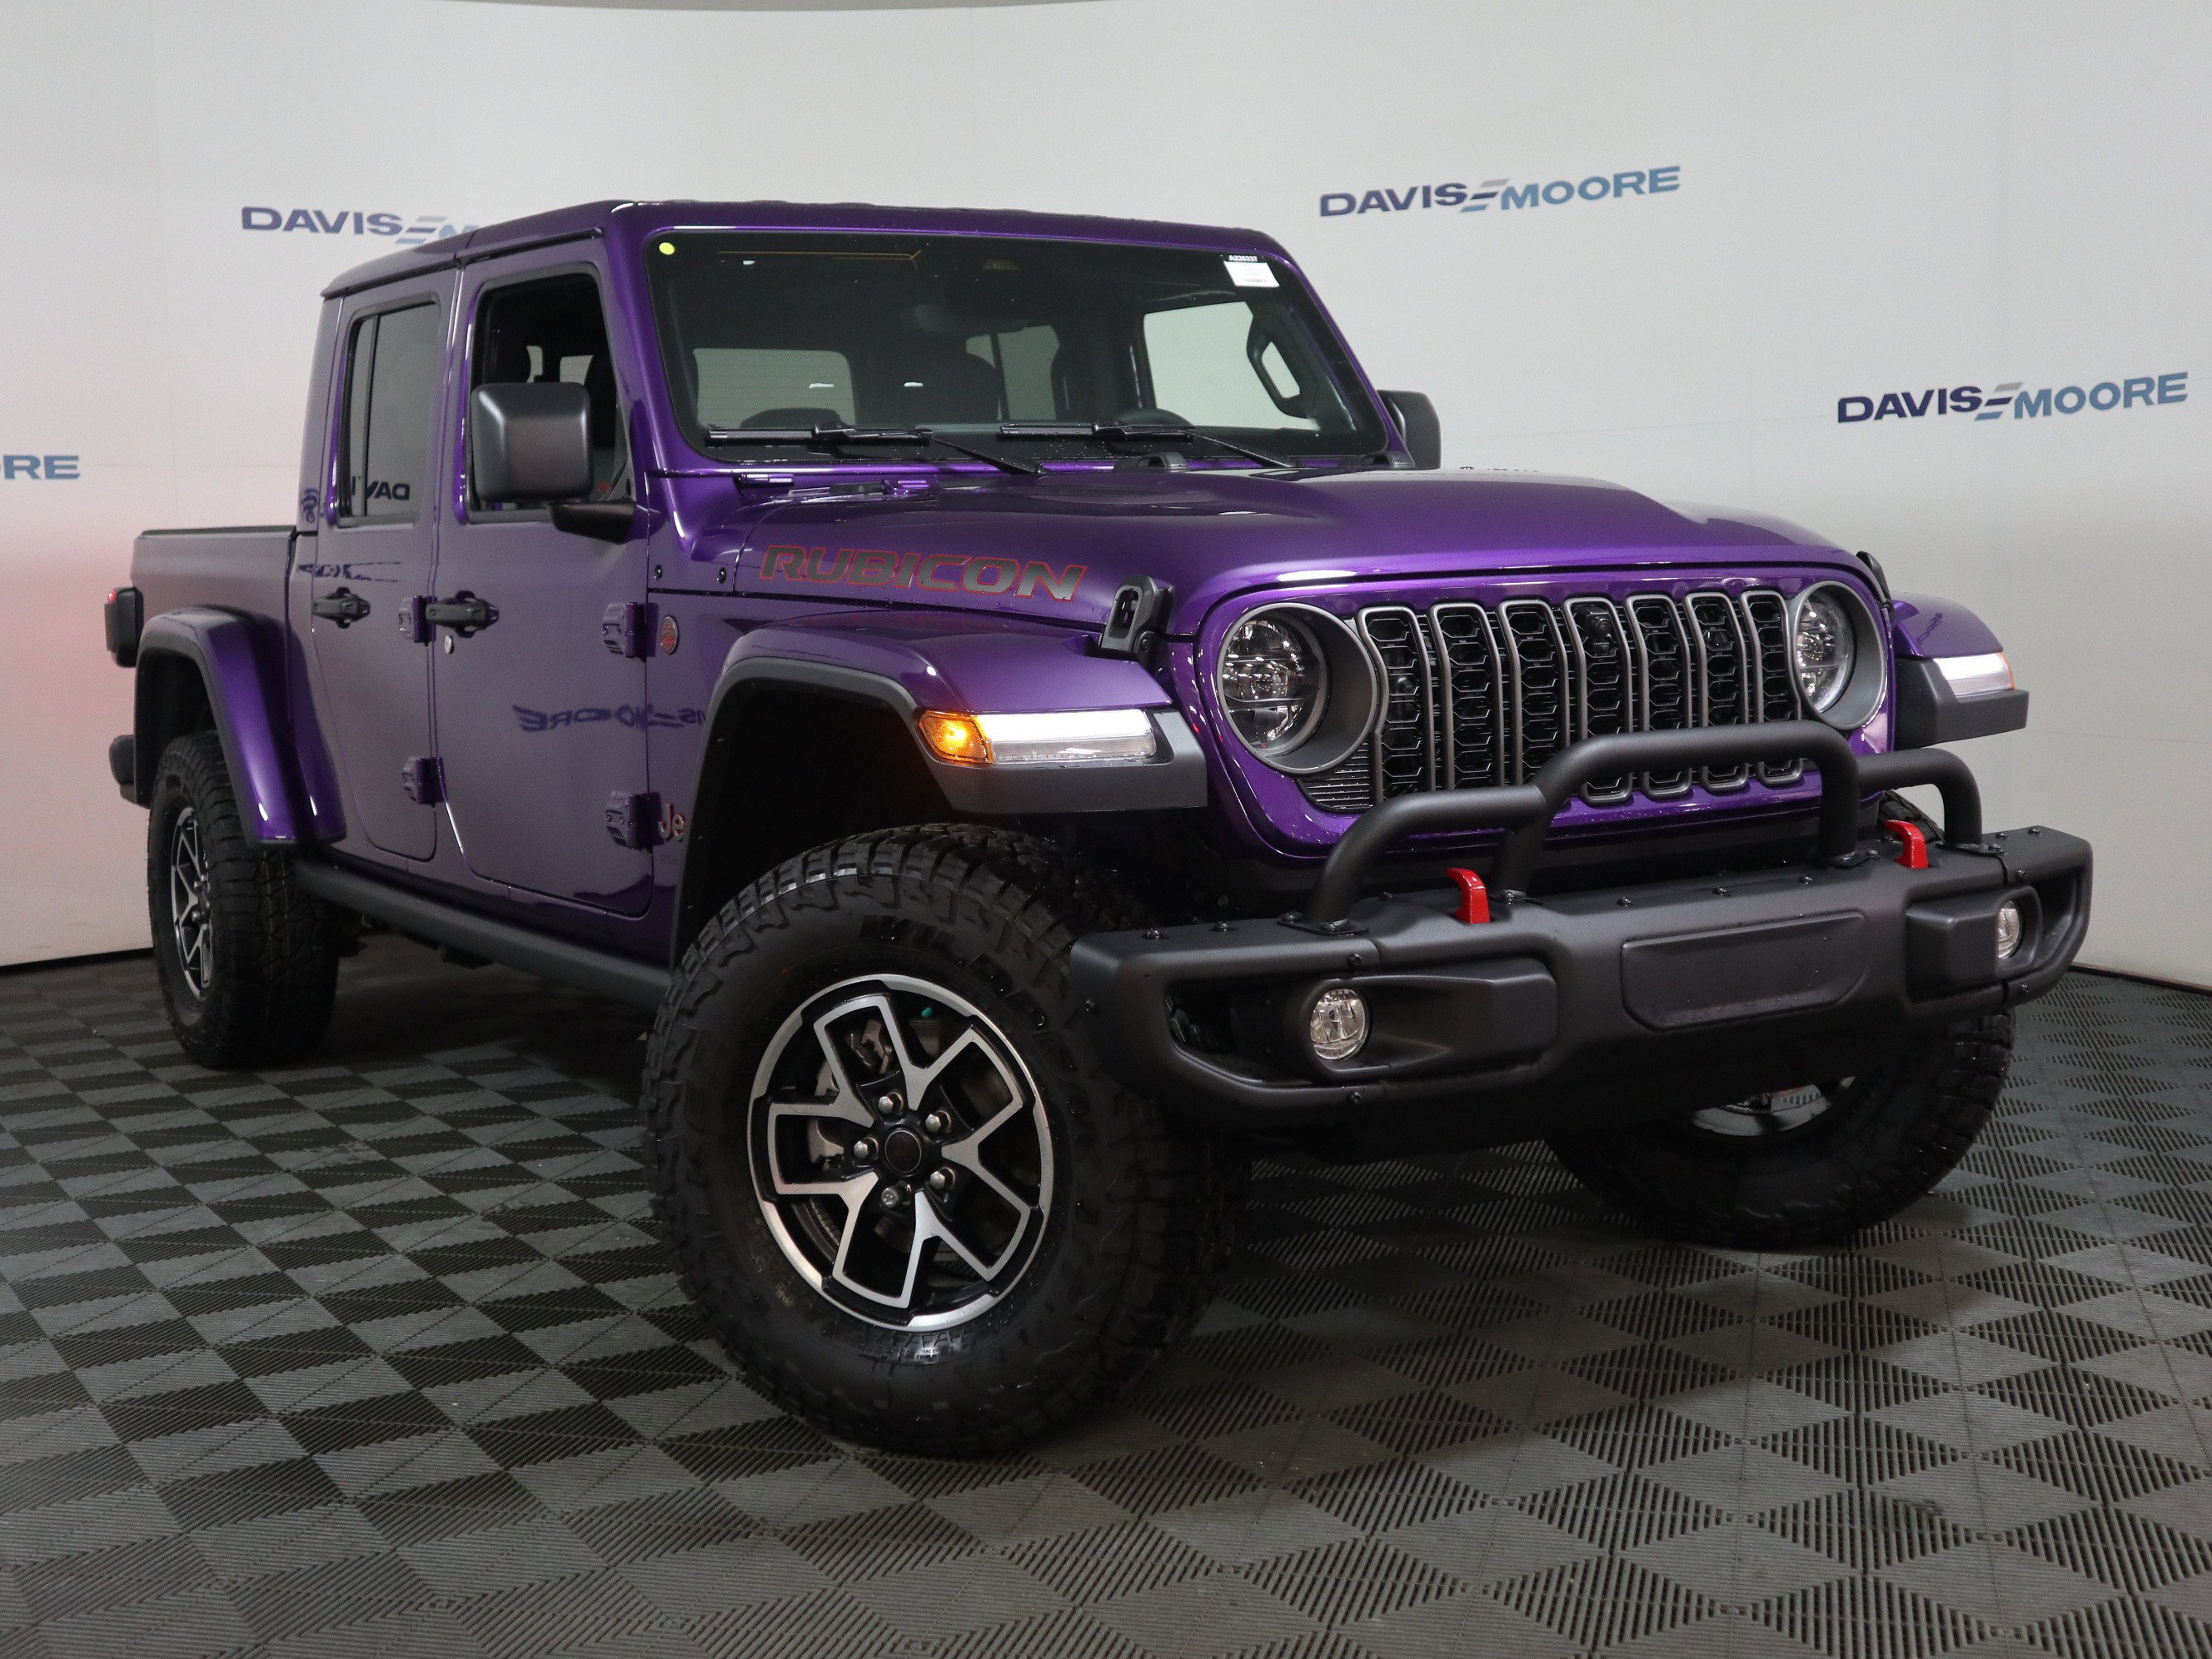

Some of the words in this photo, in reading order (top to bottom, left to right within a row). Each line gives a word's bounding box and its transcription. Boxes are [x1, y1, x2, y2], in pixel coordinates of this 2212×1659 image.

[1319, 182, 1467, 217] DAVIS
[1501, 165, 1681, 211] MOORE
[241, 206, 402, 236] DAVIS
[1837, 386, 1982, 423] DAVIS
[2014, 371, 2189, 420] MOORE
[0, 455, 80, 480] RE
[759, 545, 1088, 603] RUBICON
[657, 802, 686, 841] Je
